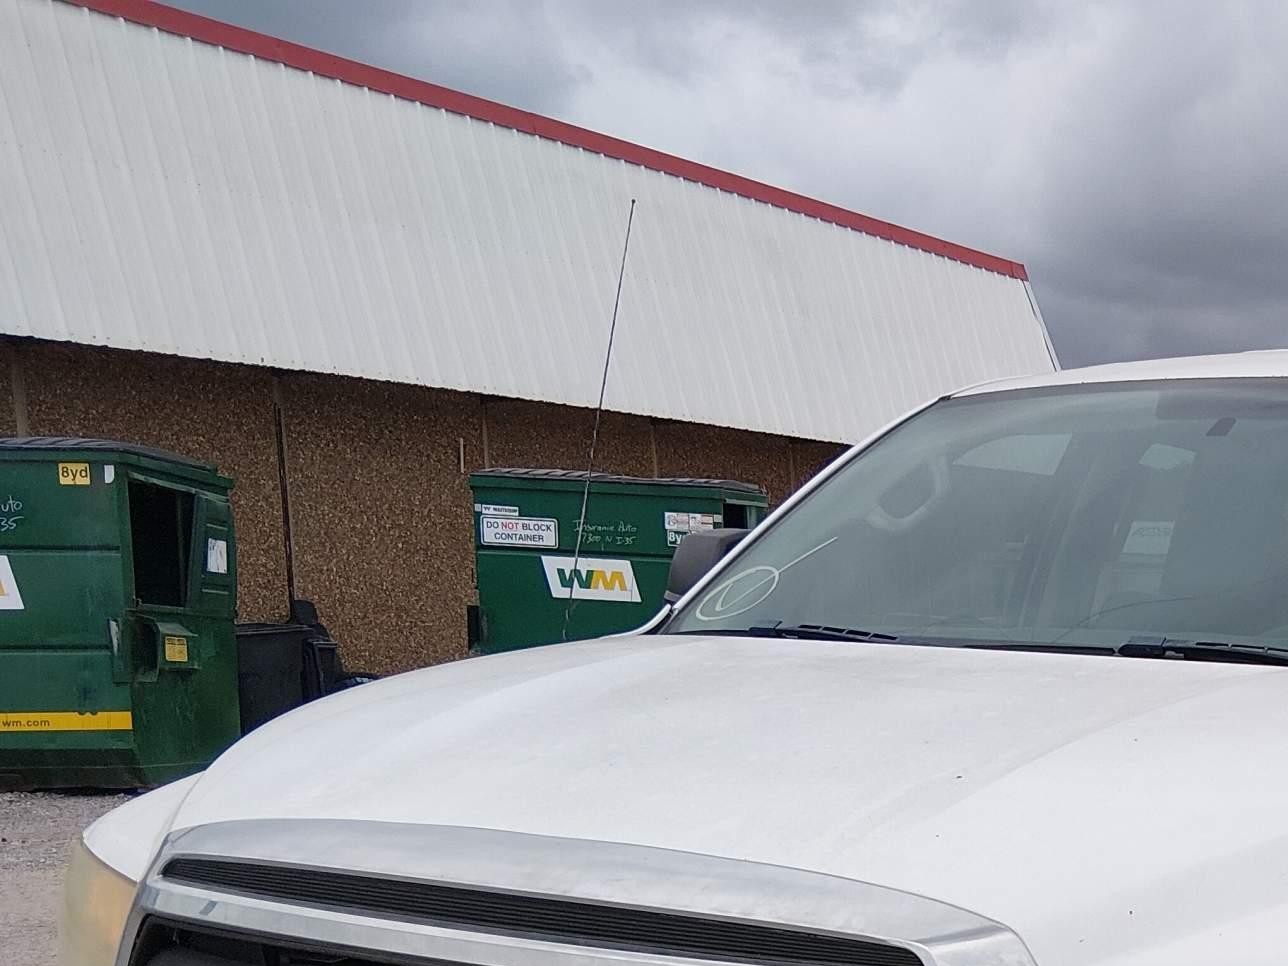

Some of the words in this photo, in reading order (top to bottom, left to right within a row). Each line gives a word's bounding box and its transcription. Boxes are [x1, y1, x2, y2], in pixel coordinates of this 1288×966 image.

[1, 495, 23, 512] uto
[0, 516, 24, 532] 35
[486, 521, 499, 529] DO
[501, 522, 519, 530] NOT
[521, 523, 552, 532] BLOCK
[494, 532, 545, 543] CONTAINER
[669, 532, 682, 544] 8y
[556, 568, 628, 591] WM
[2, 719, 50, 727] wm.com
